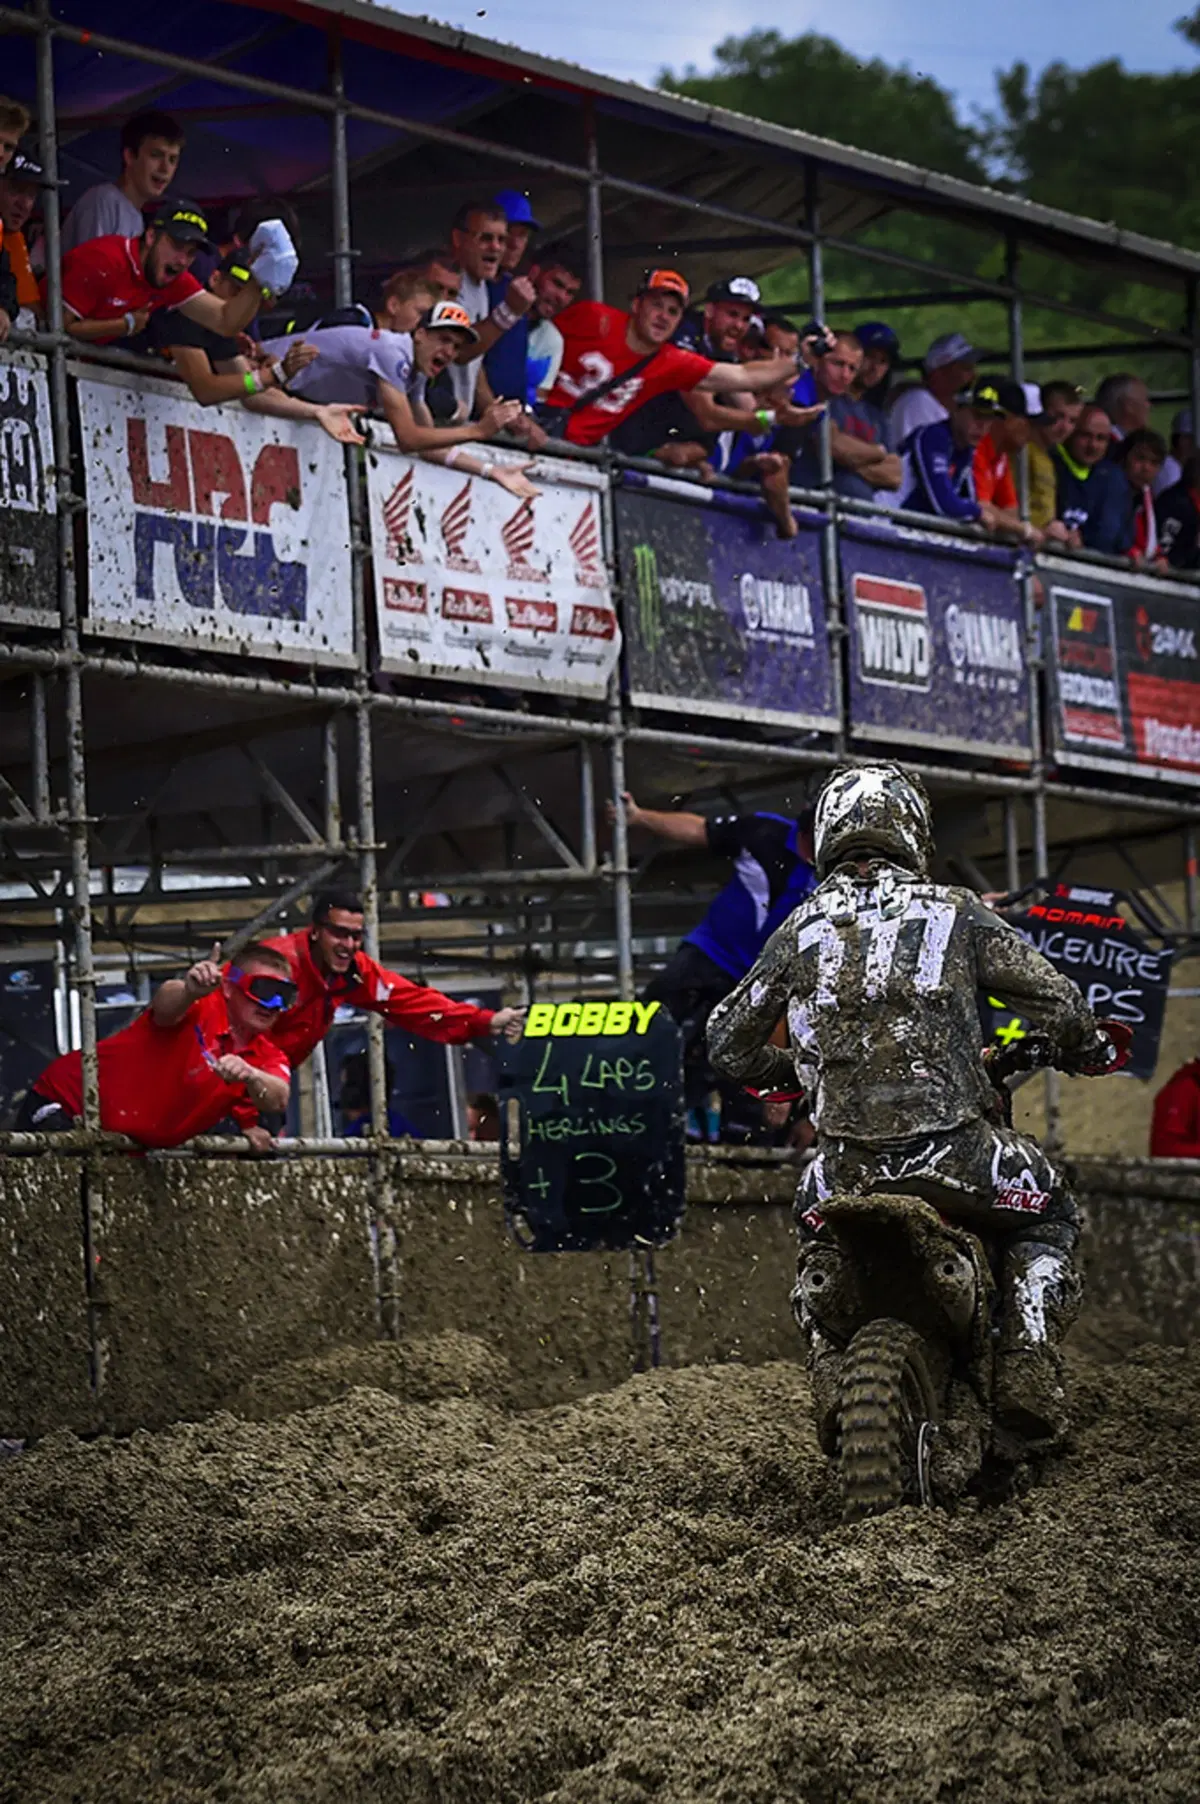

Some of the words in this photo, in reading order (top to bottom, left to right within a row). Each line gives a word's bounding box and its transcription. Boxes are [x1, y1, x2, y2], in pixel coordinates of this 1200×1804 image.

[523, 1001, 662, 1037] BOBBY
[532, 1041, 569, 1106] 4
[580, 1054, 656, 1091] LAPS
[527, 1113, 646, 1144] HERLINGS
[575, 1152, 622, 1213] 3
